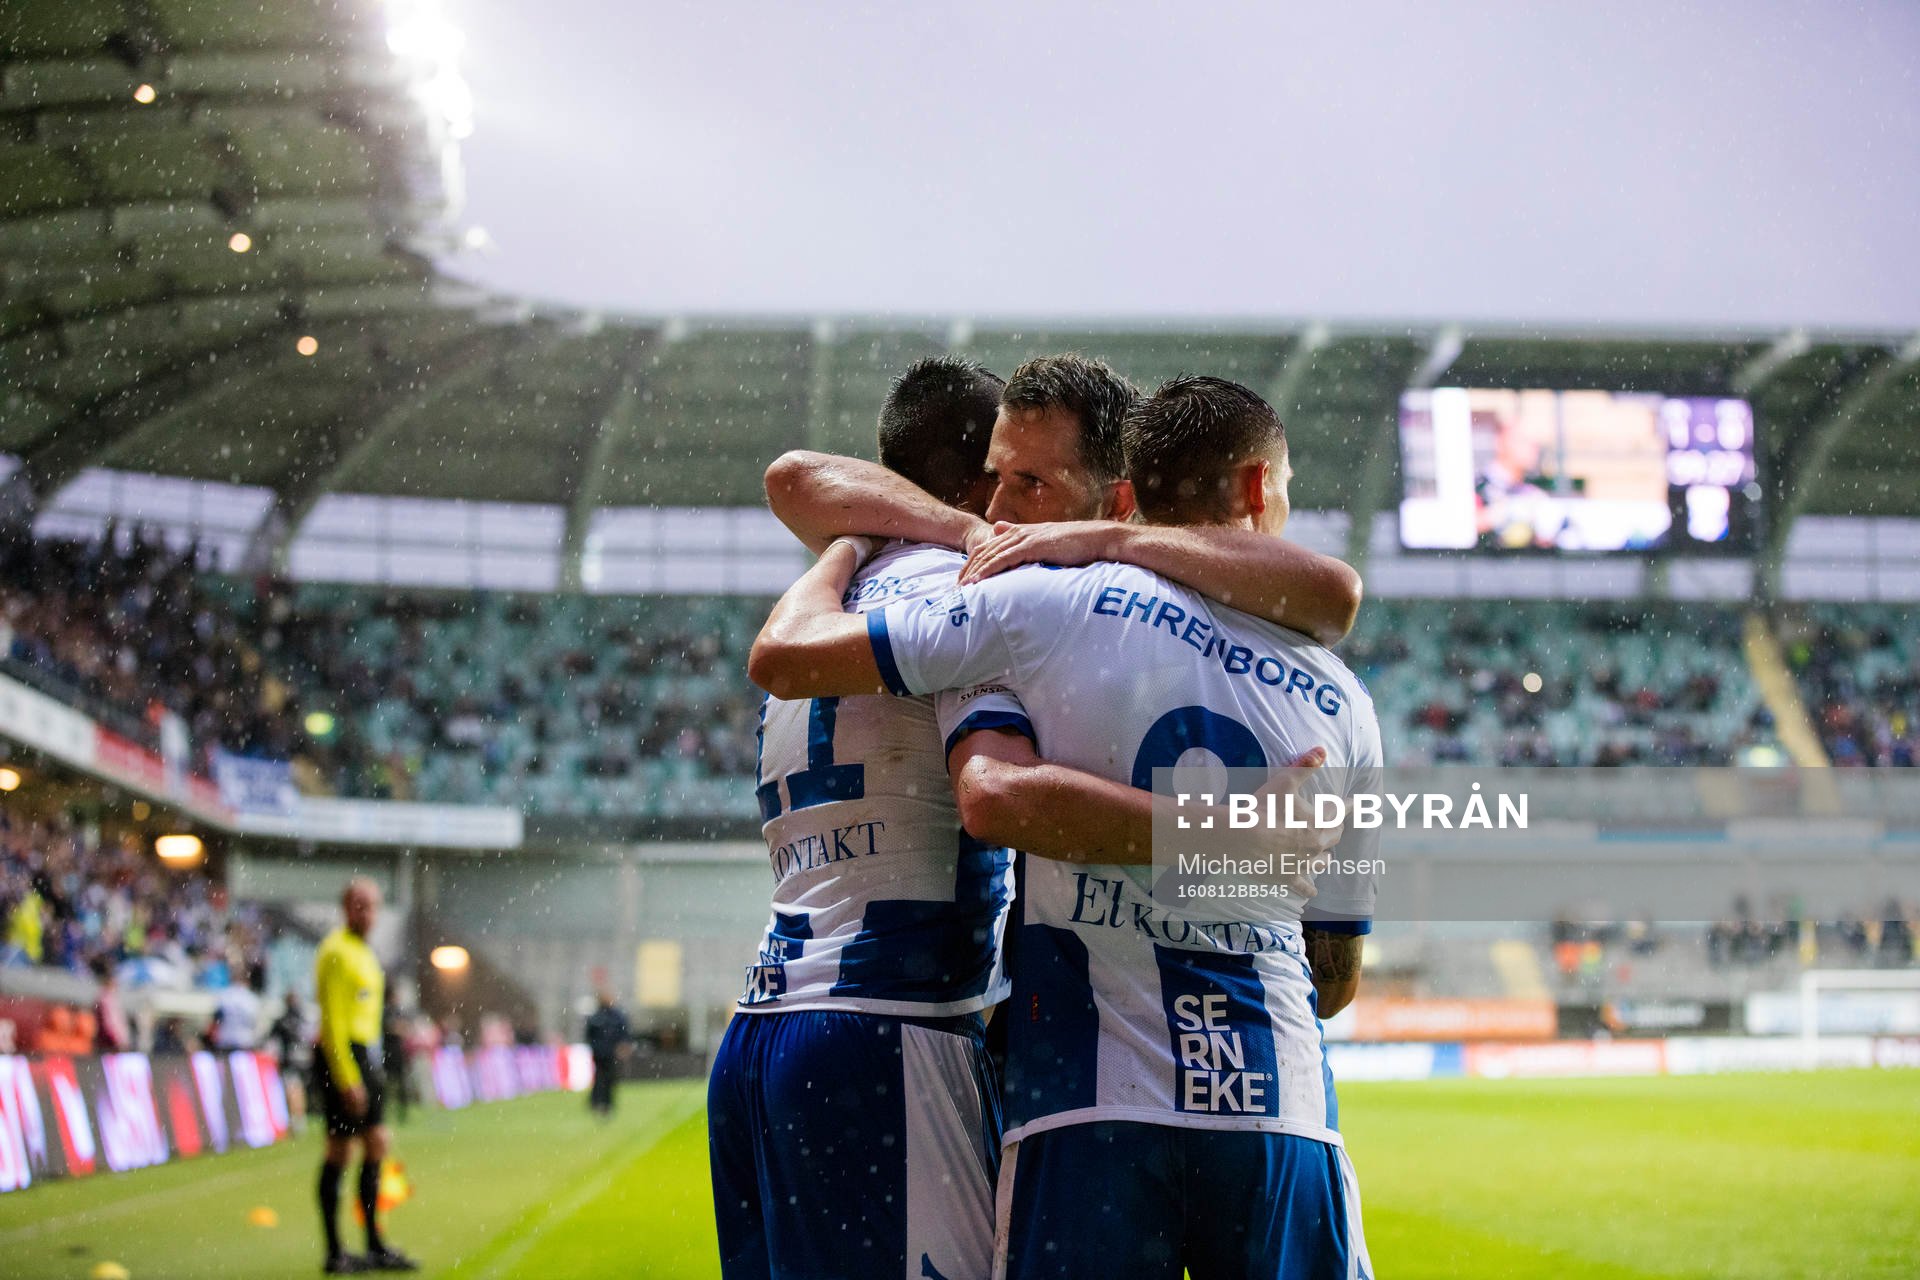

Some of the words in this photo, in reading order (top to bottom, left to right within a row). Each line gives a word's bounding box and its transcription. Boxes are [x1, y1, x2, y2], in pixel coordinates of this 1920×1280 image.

[1092, 586, 1342, 716] EHRENBORG
[1174, 994, 1232, 1031] SE
[1179, 1032, 1246, 1070] RN
[1183, 1069, 1267, 1113] EKE
